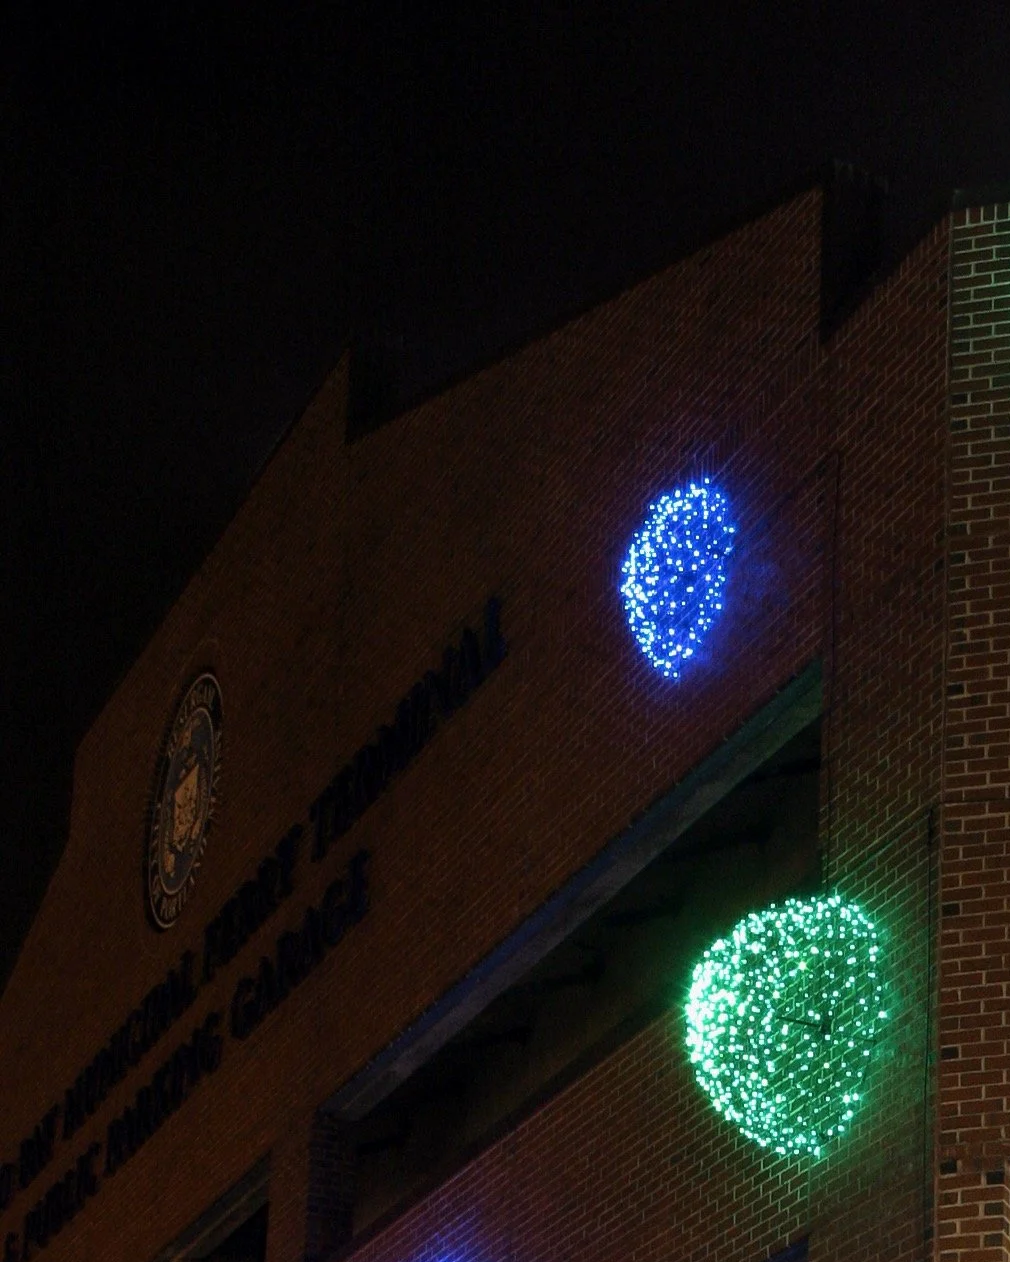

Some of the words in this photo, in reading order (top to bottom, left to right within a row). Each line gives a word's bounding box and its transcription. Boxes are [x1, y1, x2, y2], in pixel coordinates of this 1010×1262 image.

[202, 823, 303, 982] FERRY
[310, 597, 507, 862] TERMINAL
[105, 1011, 223, 1177] PARKING
[229, 850, 370, 1040] GARAGE
